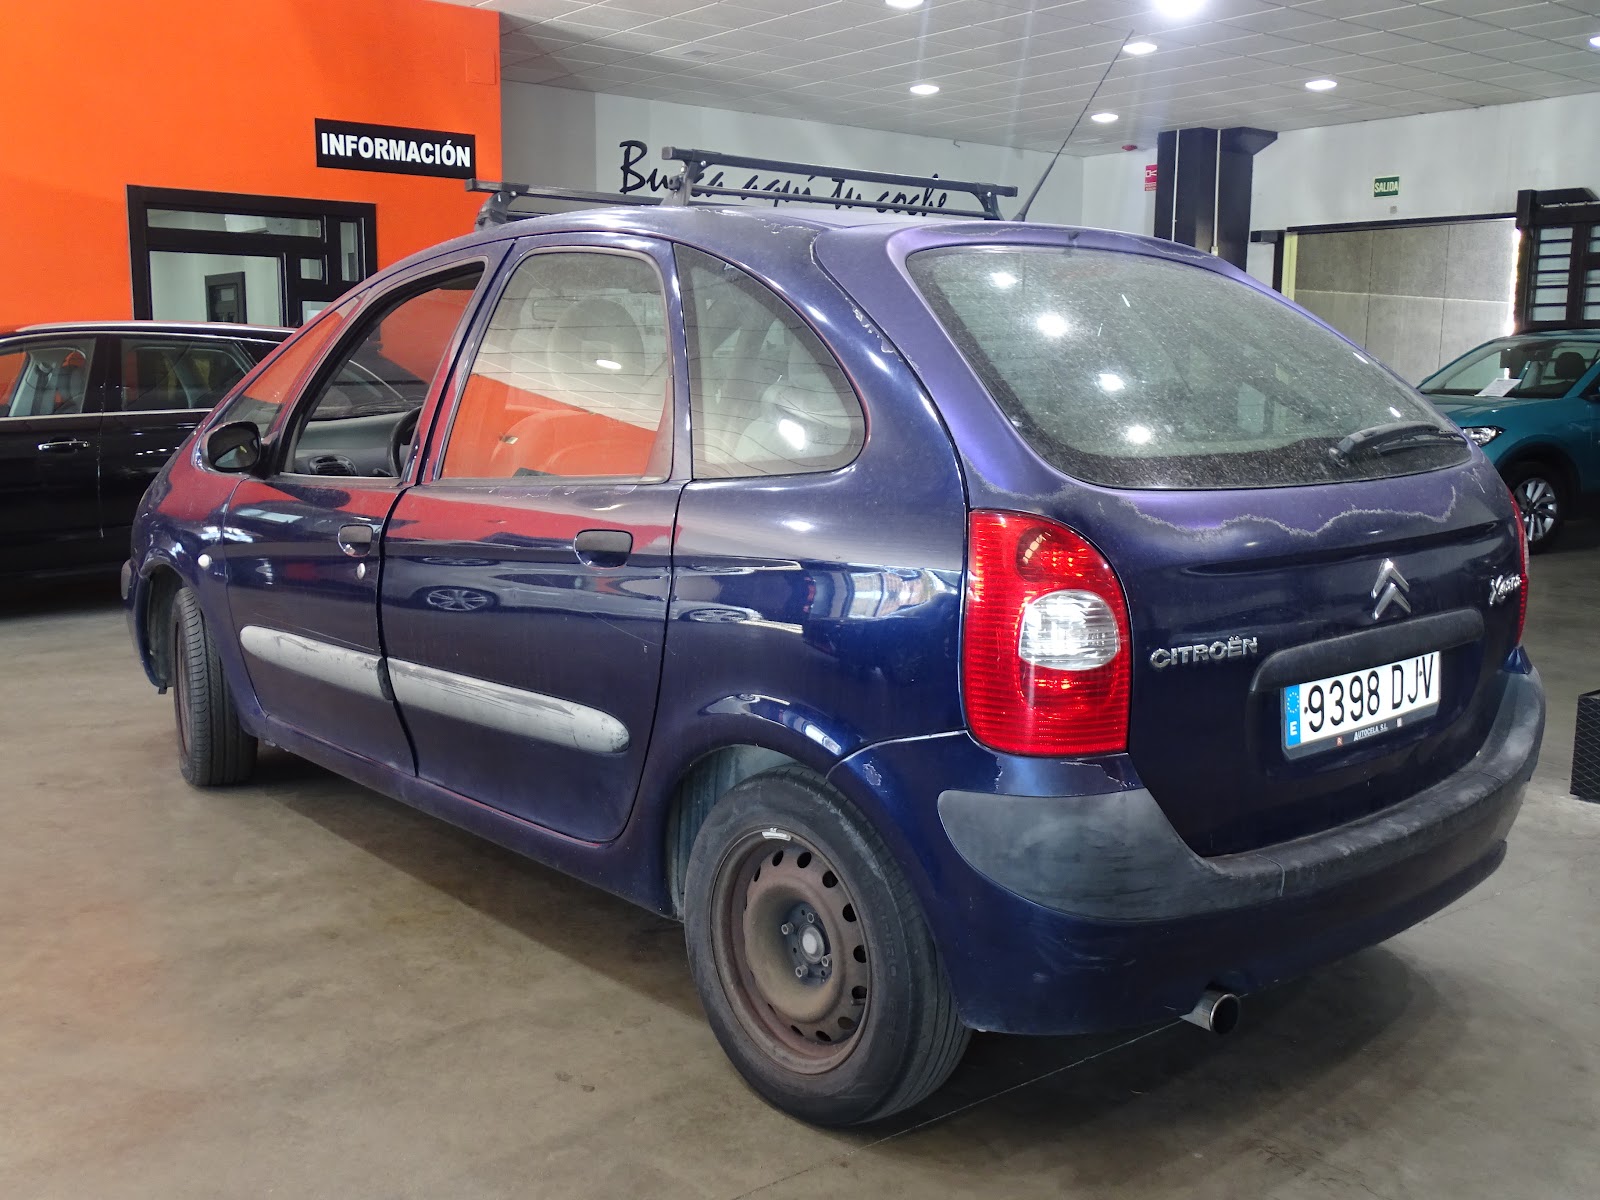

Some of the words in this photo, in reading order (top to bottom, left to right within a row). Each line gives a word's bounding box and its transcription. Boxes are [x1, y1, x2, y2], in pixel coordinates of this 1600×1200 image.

[321, 132, 471, 167] INFORMACIÓN
[619, 140, 724, 197] Buca
[1374, 181, 1399, 193] SALIDA
[1149, 635, 1258, 668] CITROËN
[1307, 670, 1380, 732] 9398
[1392, 653, 1435, 710] DJV
[1290, 720, 1298, 736] E
